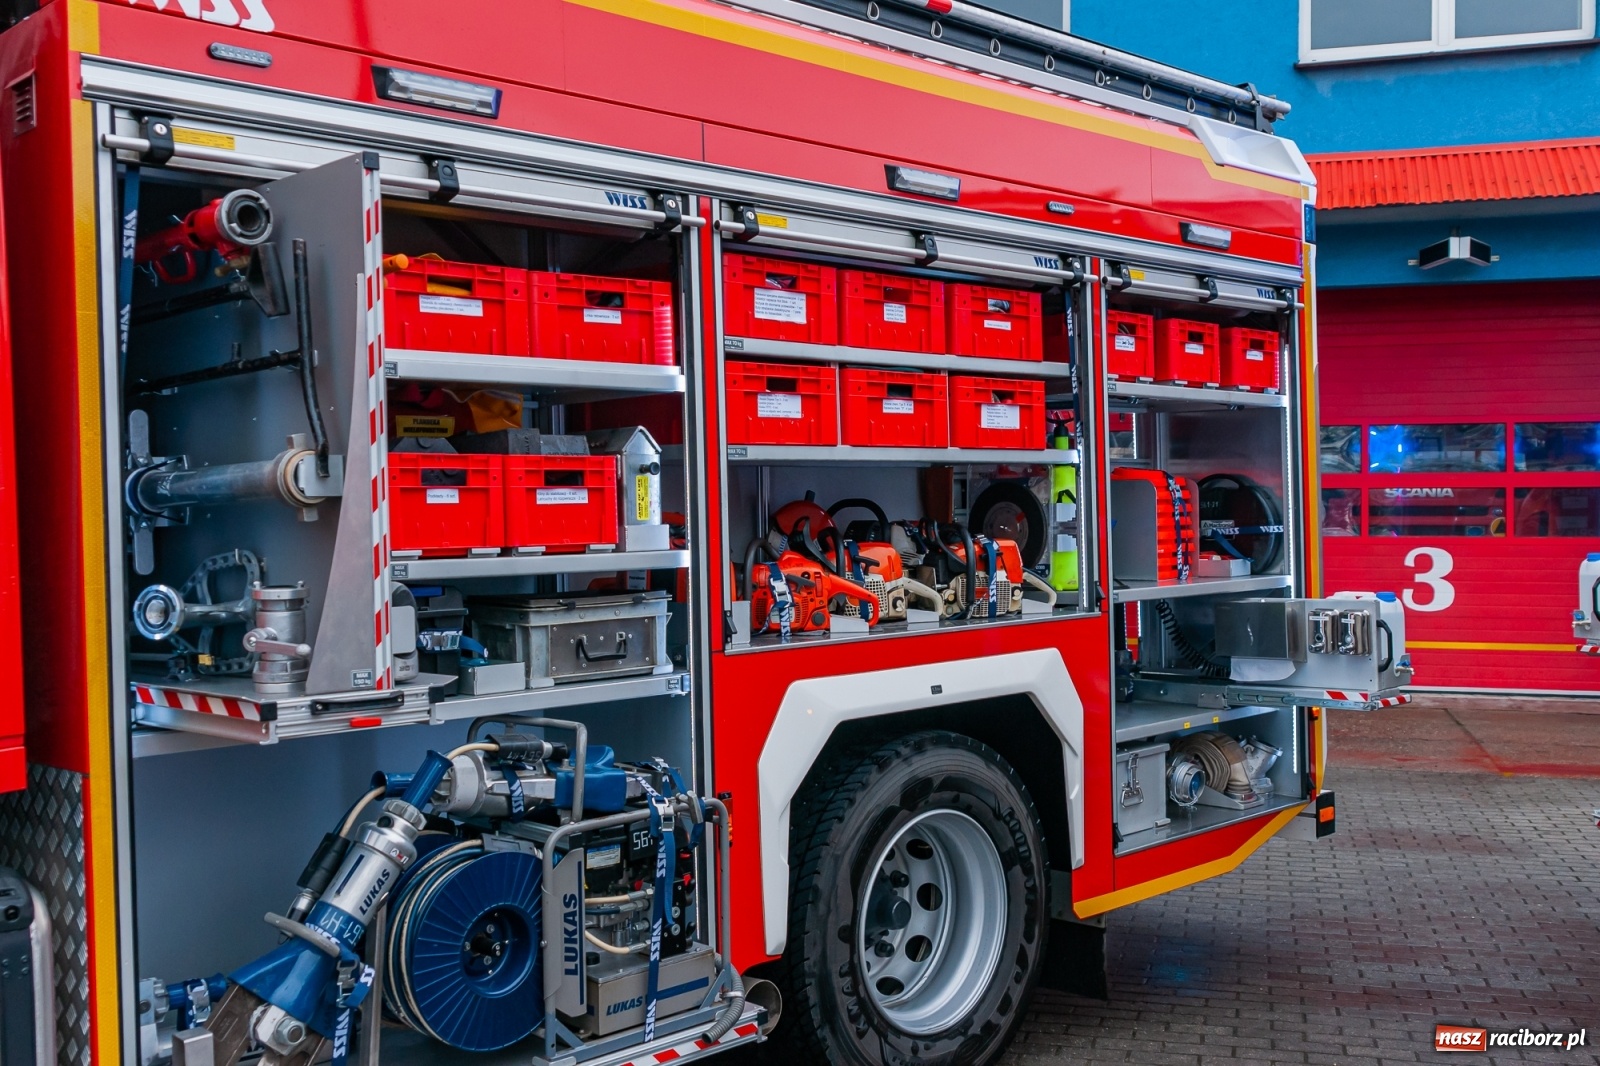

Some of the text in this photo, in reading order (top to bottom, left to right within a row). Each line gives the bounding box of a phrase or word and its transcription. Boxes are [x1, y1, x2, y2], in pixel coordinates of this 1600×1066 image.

[604, 191, 647, 210] WISS
[122, 209, 138, 260] WISS
[1033, 255, 1060, 270] WISS
[1256, 287, 1276, 300] WISS
[1066, 306, 1075, 338] WISS
[1071, 364, 1079, 395] WISS
[1384, 488, 1454, 498] SCANIA
[1215, 527, 1240, 535] WISS
[1259, 525, 1284, 533] WISS
[989, 571, 997, 603] WISS
[1402, 546, 1455, 612] 3
[510, 779, 524, 813] WISS
[359, 868, 390, 916] LUKAS
[563, 893, 579, 976] LUKAS
[650, 917, 663, 962] WISS
[606, 996, 643, 1017] LUKAS
[645, 998, 657, 1044] WISS
[333, 1008, 350, 1059] WISS
